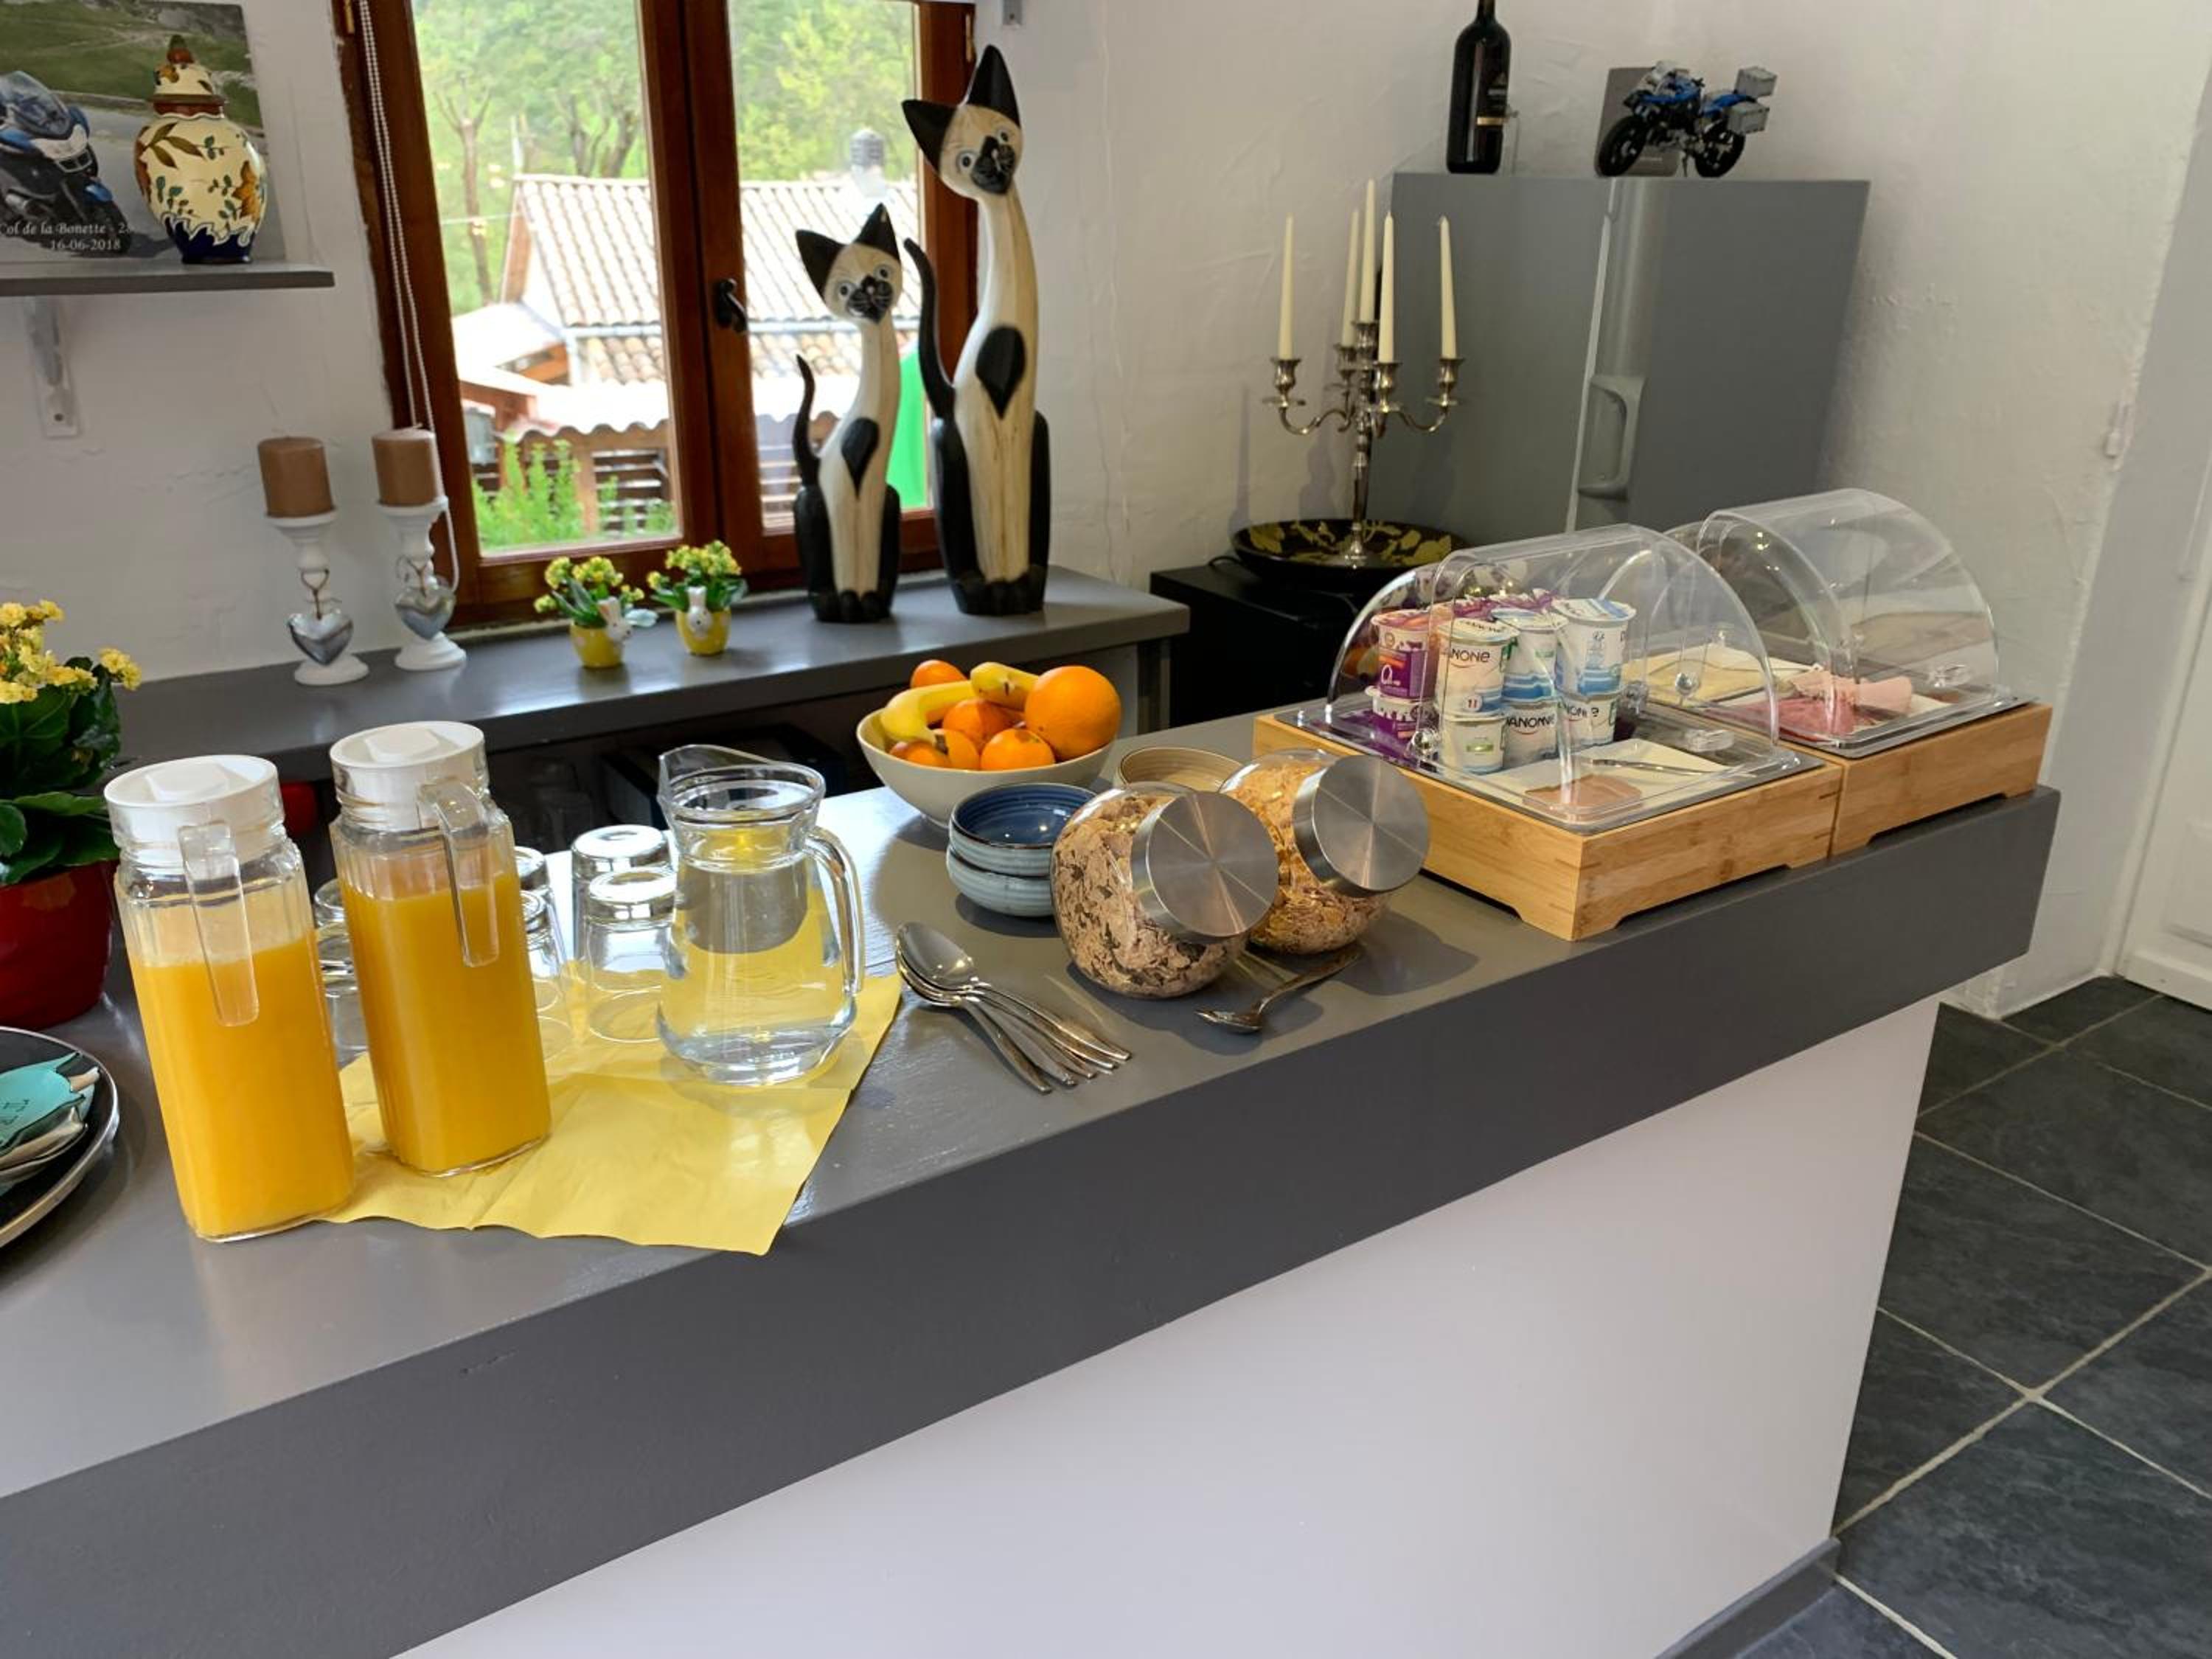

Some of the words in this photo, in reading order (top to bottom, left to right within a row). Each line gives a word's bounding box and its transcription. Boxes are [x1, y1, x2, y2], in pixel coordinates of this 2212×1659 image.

[22, 221, 36, 235] de
[41, 220, 52, 235] la
[51, 239, 121, 251] 16-06-2018
